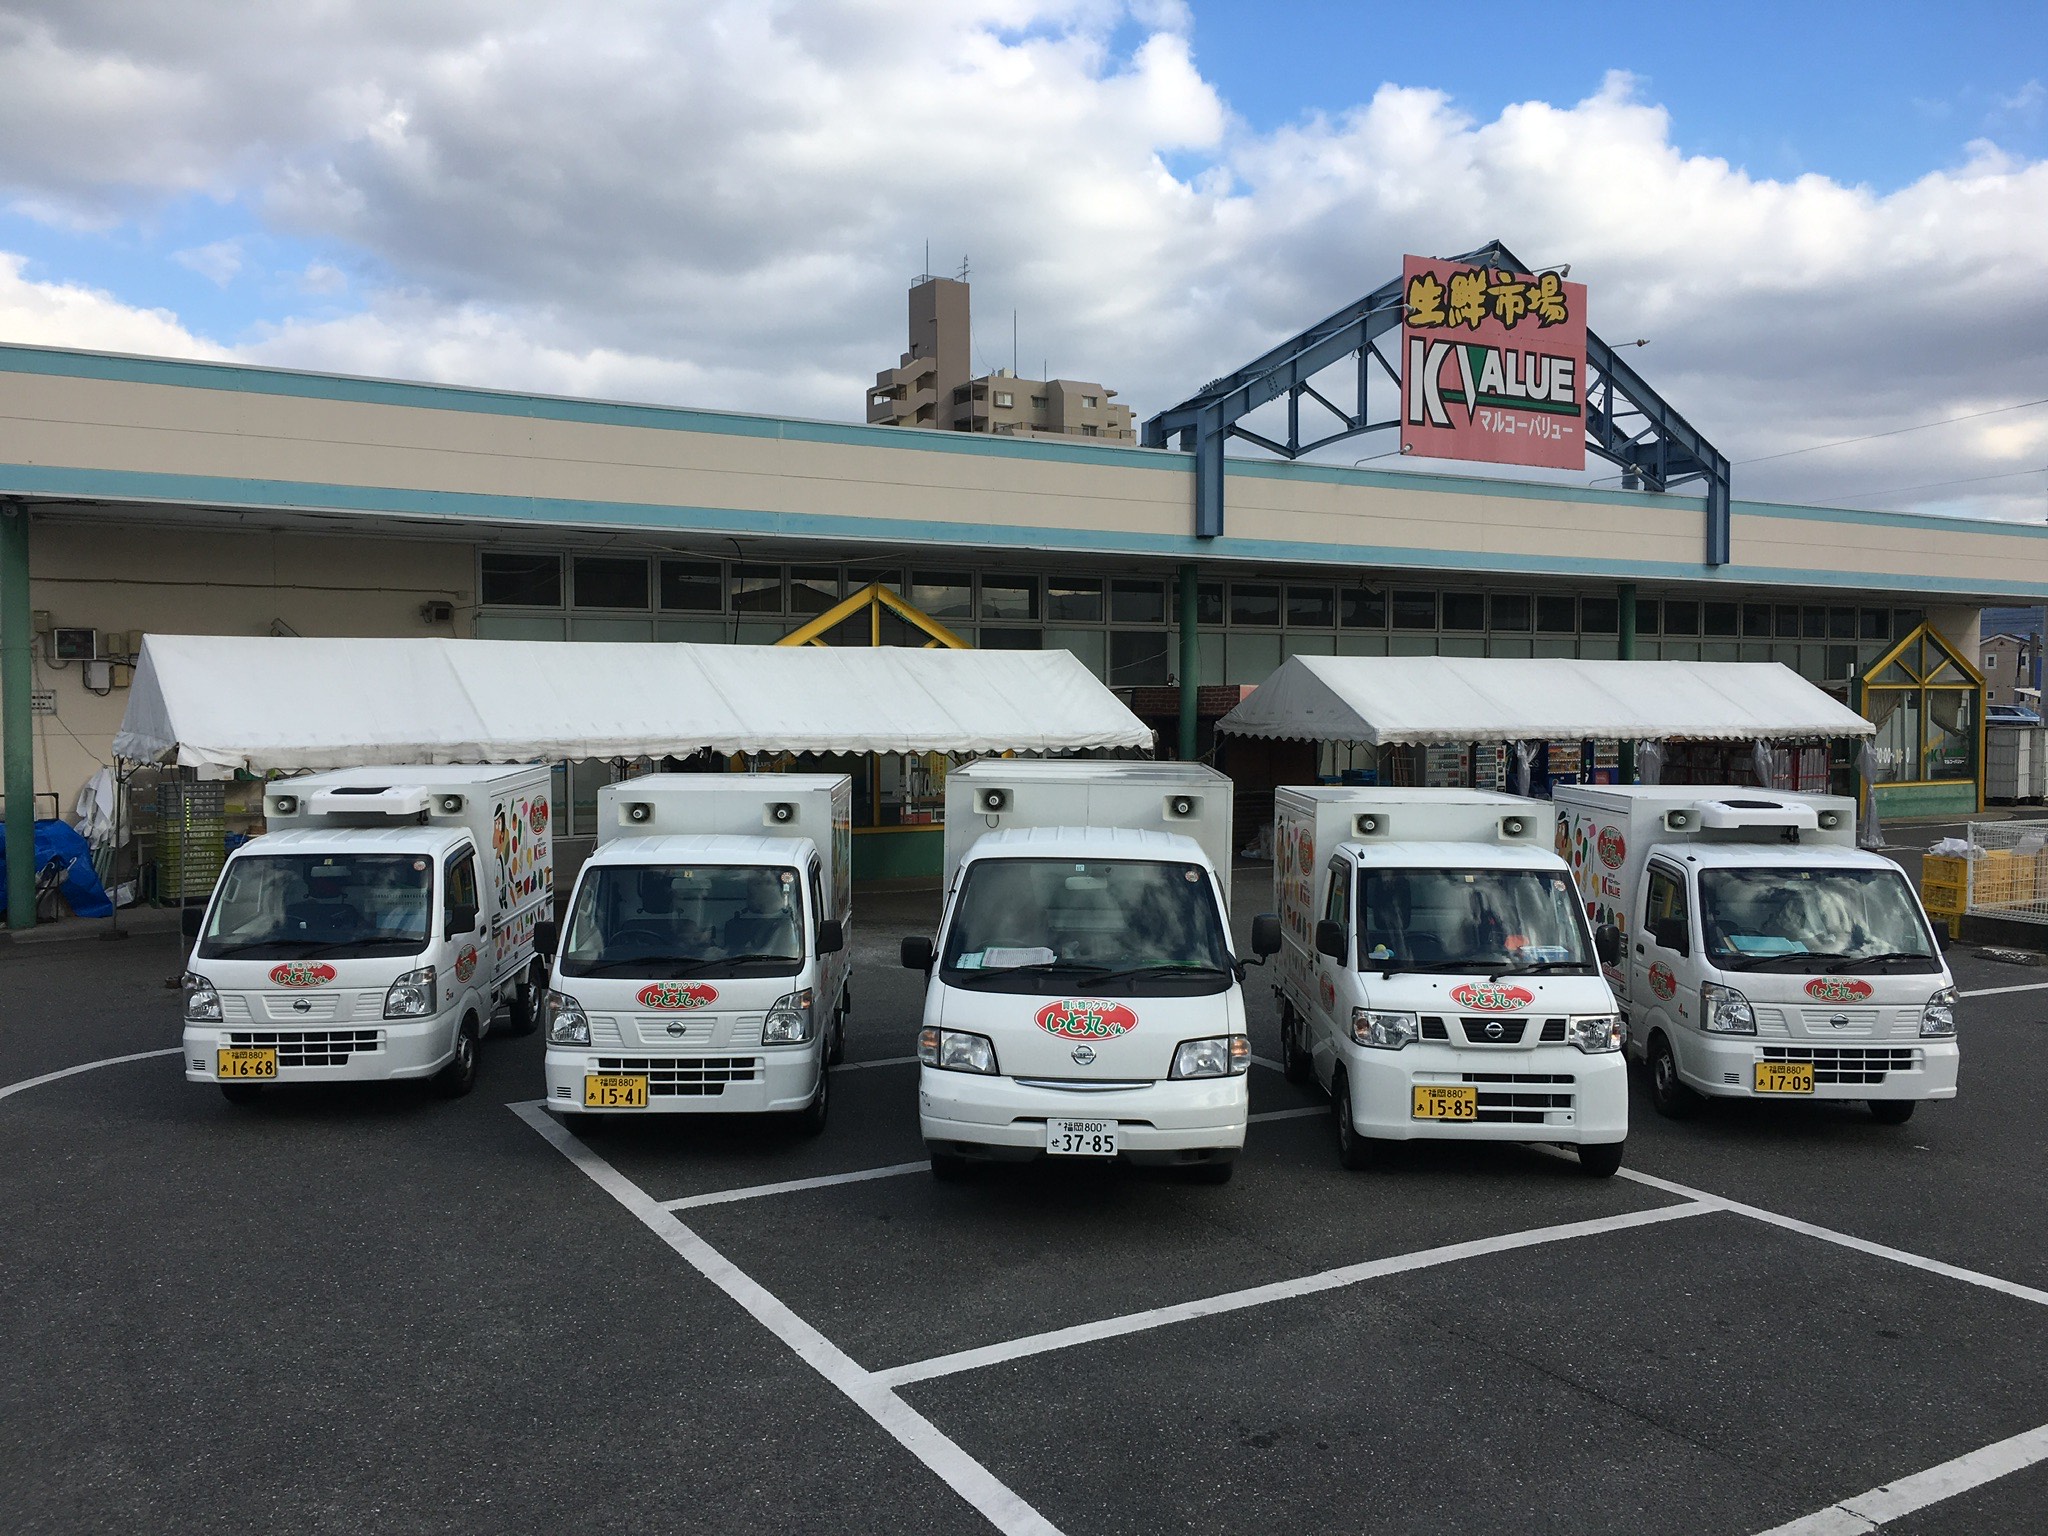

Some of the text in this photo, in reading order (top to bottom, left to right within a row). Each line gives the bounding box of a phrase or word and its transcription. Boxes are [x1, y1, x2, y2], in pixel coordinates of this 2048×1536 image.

[1406, 265, 1568, 330] 生鮮市場
[1479, 411, 1573, 439] マルコーバリュー
[1062, 1000, 1116, 1010] 買い物ワクワク
[232, 1061, 273, 1075] 16-68
[1769, 1075, 1811, 1090] 17-09
[601, 1088, 642, 1104] 15-41
[1416, 1099, 1473, 1116] あ 15-85
[1051, 1134, 1114, 1152] せ 37-85
